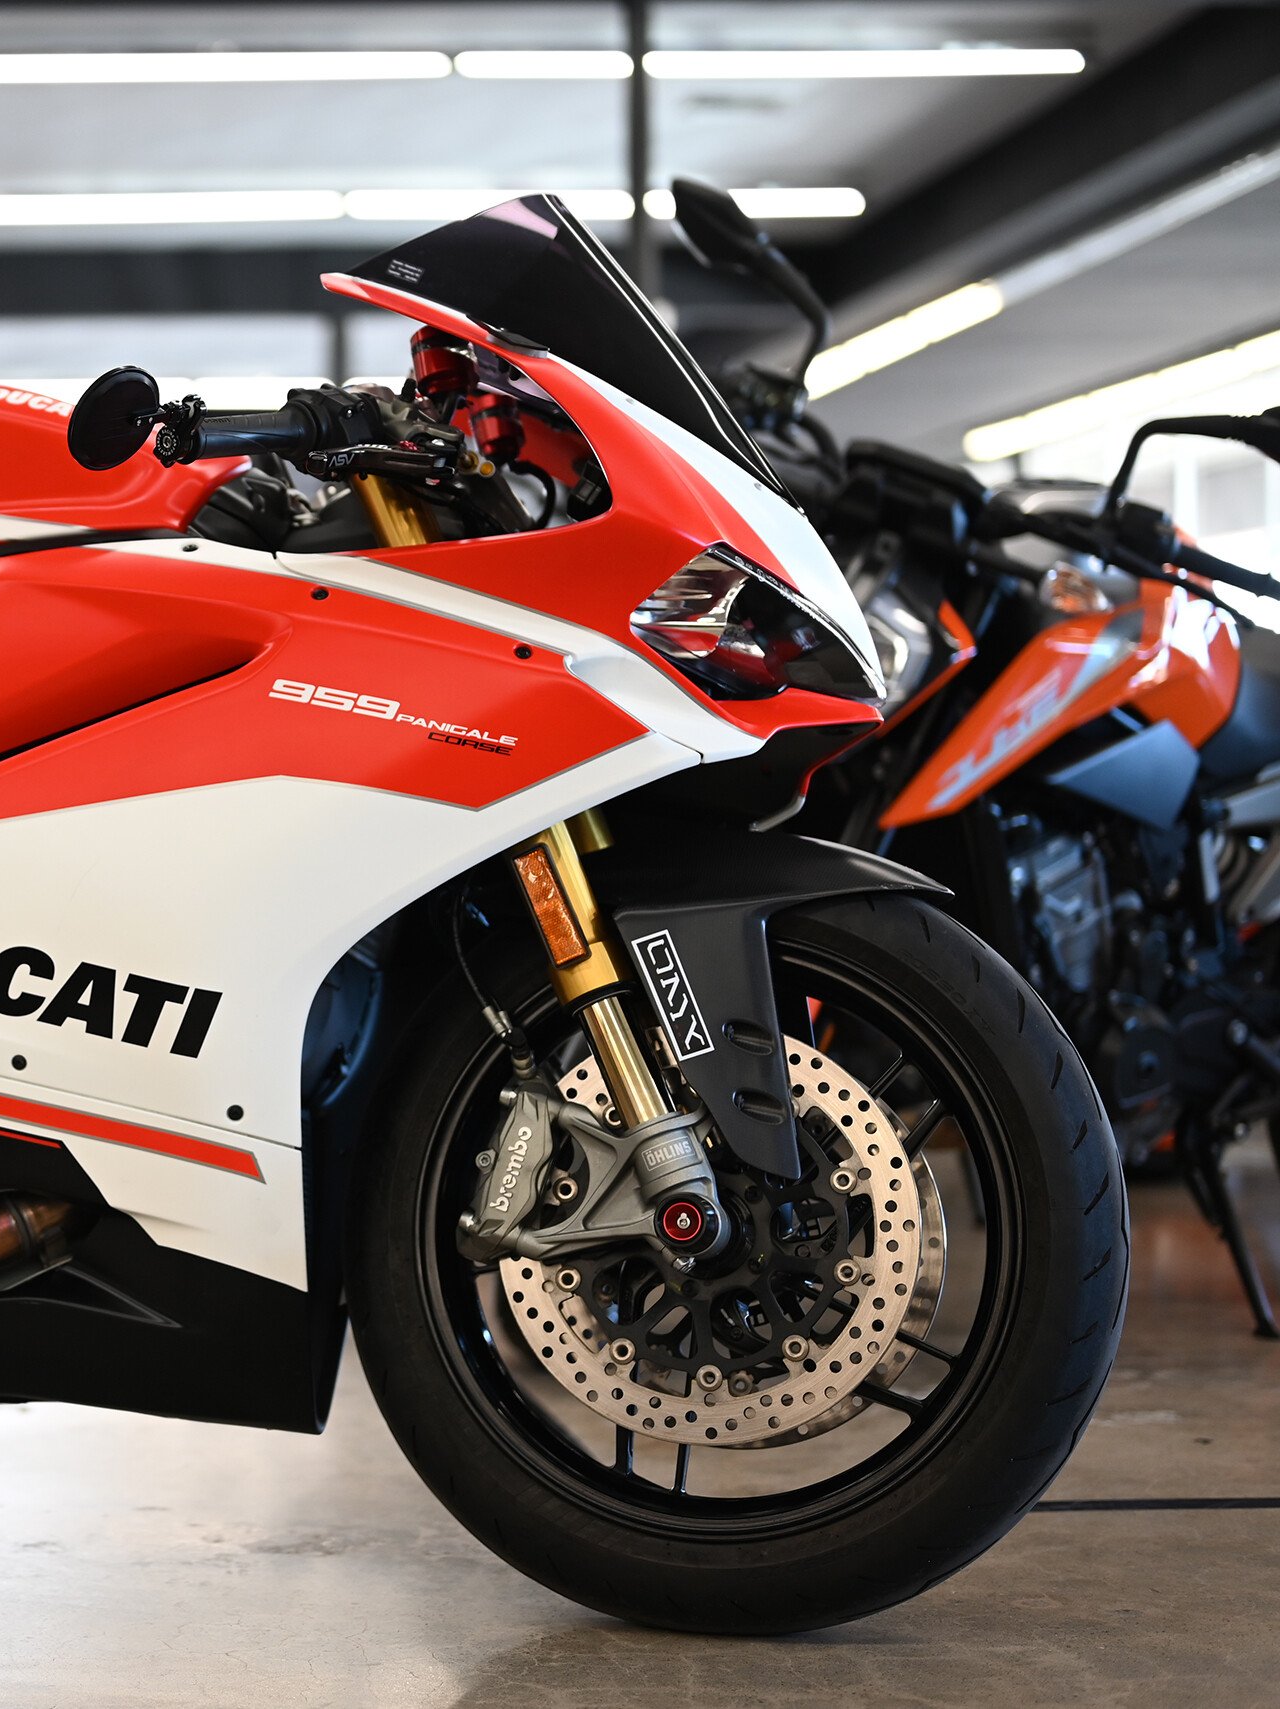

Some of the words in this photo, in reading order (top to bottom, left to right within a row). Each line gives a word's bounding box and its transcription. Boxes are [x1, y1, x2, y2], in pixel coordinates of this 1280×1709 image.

[268, 678, 401, 720] 959
[396, 713, 518, 746] PANIGALE
[428, 731, 514, 756] CORSE
[647, 938, 705, 1050] ONYX
[489, 1126, 532, 1212] brembo
[645, 1140, 693, 1167] ÖHLINS
